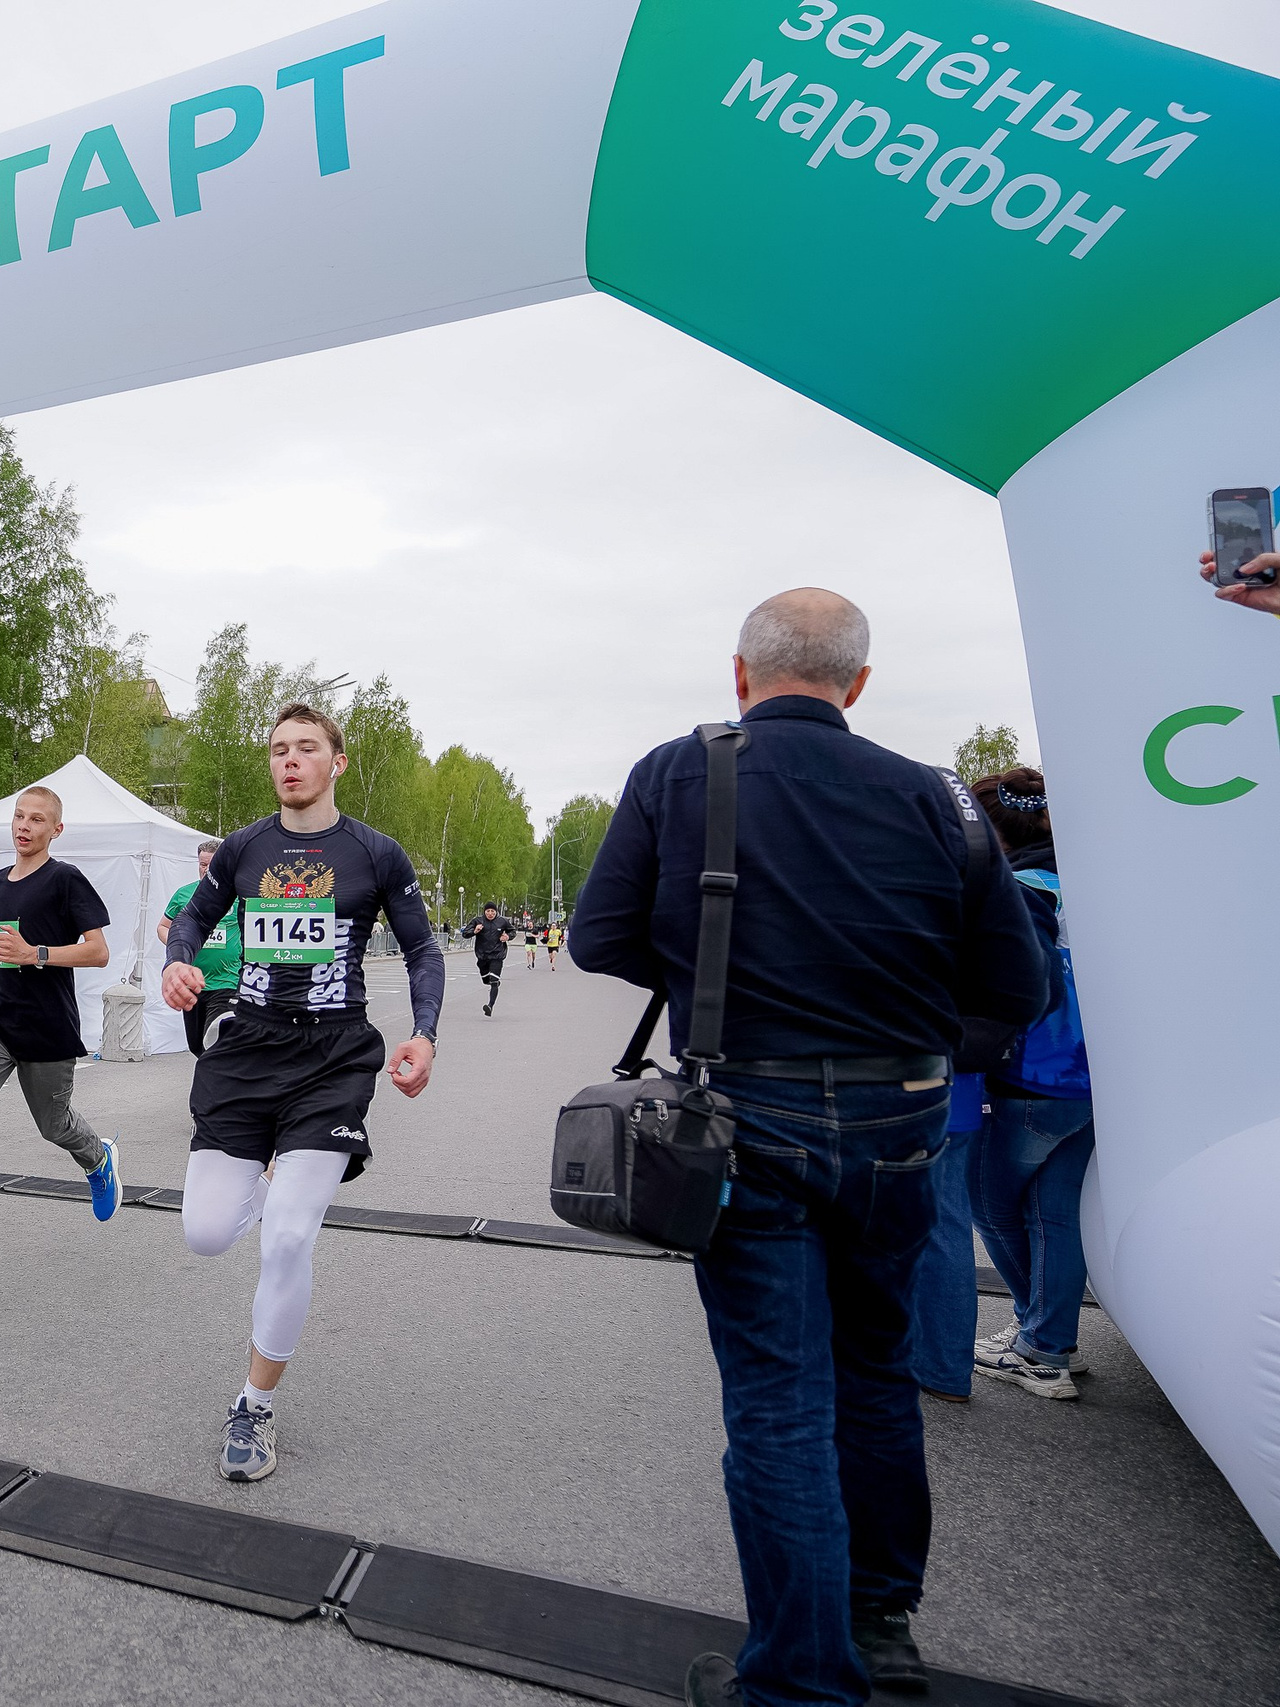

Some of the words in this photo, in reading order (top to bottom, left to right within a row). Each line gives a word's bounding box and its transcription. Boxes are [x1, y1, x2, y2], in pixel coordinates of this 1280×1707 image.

[778, 0, 1212, 181] зелёный
[720, 58, 1127, 260] марафон
[941, 772, 979, 821] SONY
[1143, 694, 1280, 806] С
[254, 917, 326, 943] 1145
